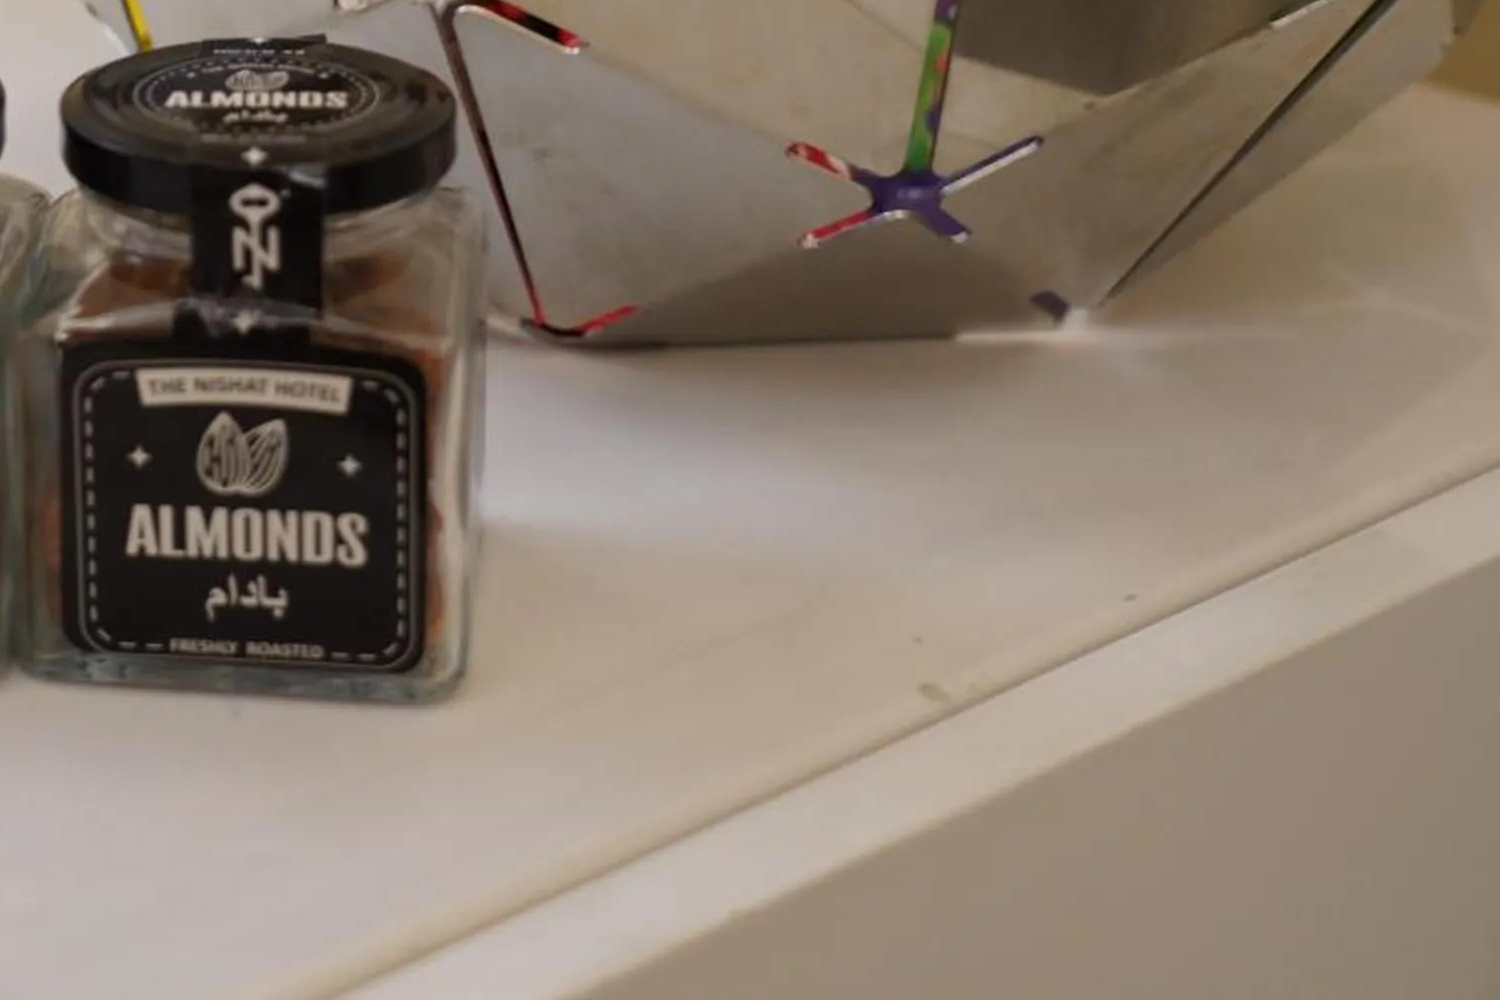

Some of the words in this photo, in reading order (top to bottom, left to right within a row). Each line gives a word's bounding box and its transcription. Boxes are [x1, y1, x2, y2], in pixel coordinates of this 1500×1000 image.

[164, 90, 349, 109] ALMONDS
[148, 377, 187, 395] THE
[274, 380, 342, 404] HOTEL
[125, 503, 369, 568] ALMONDS
[169, 637, 239, 657] FRESHLY
[244, 641, 325, 661] ROASTED
